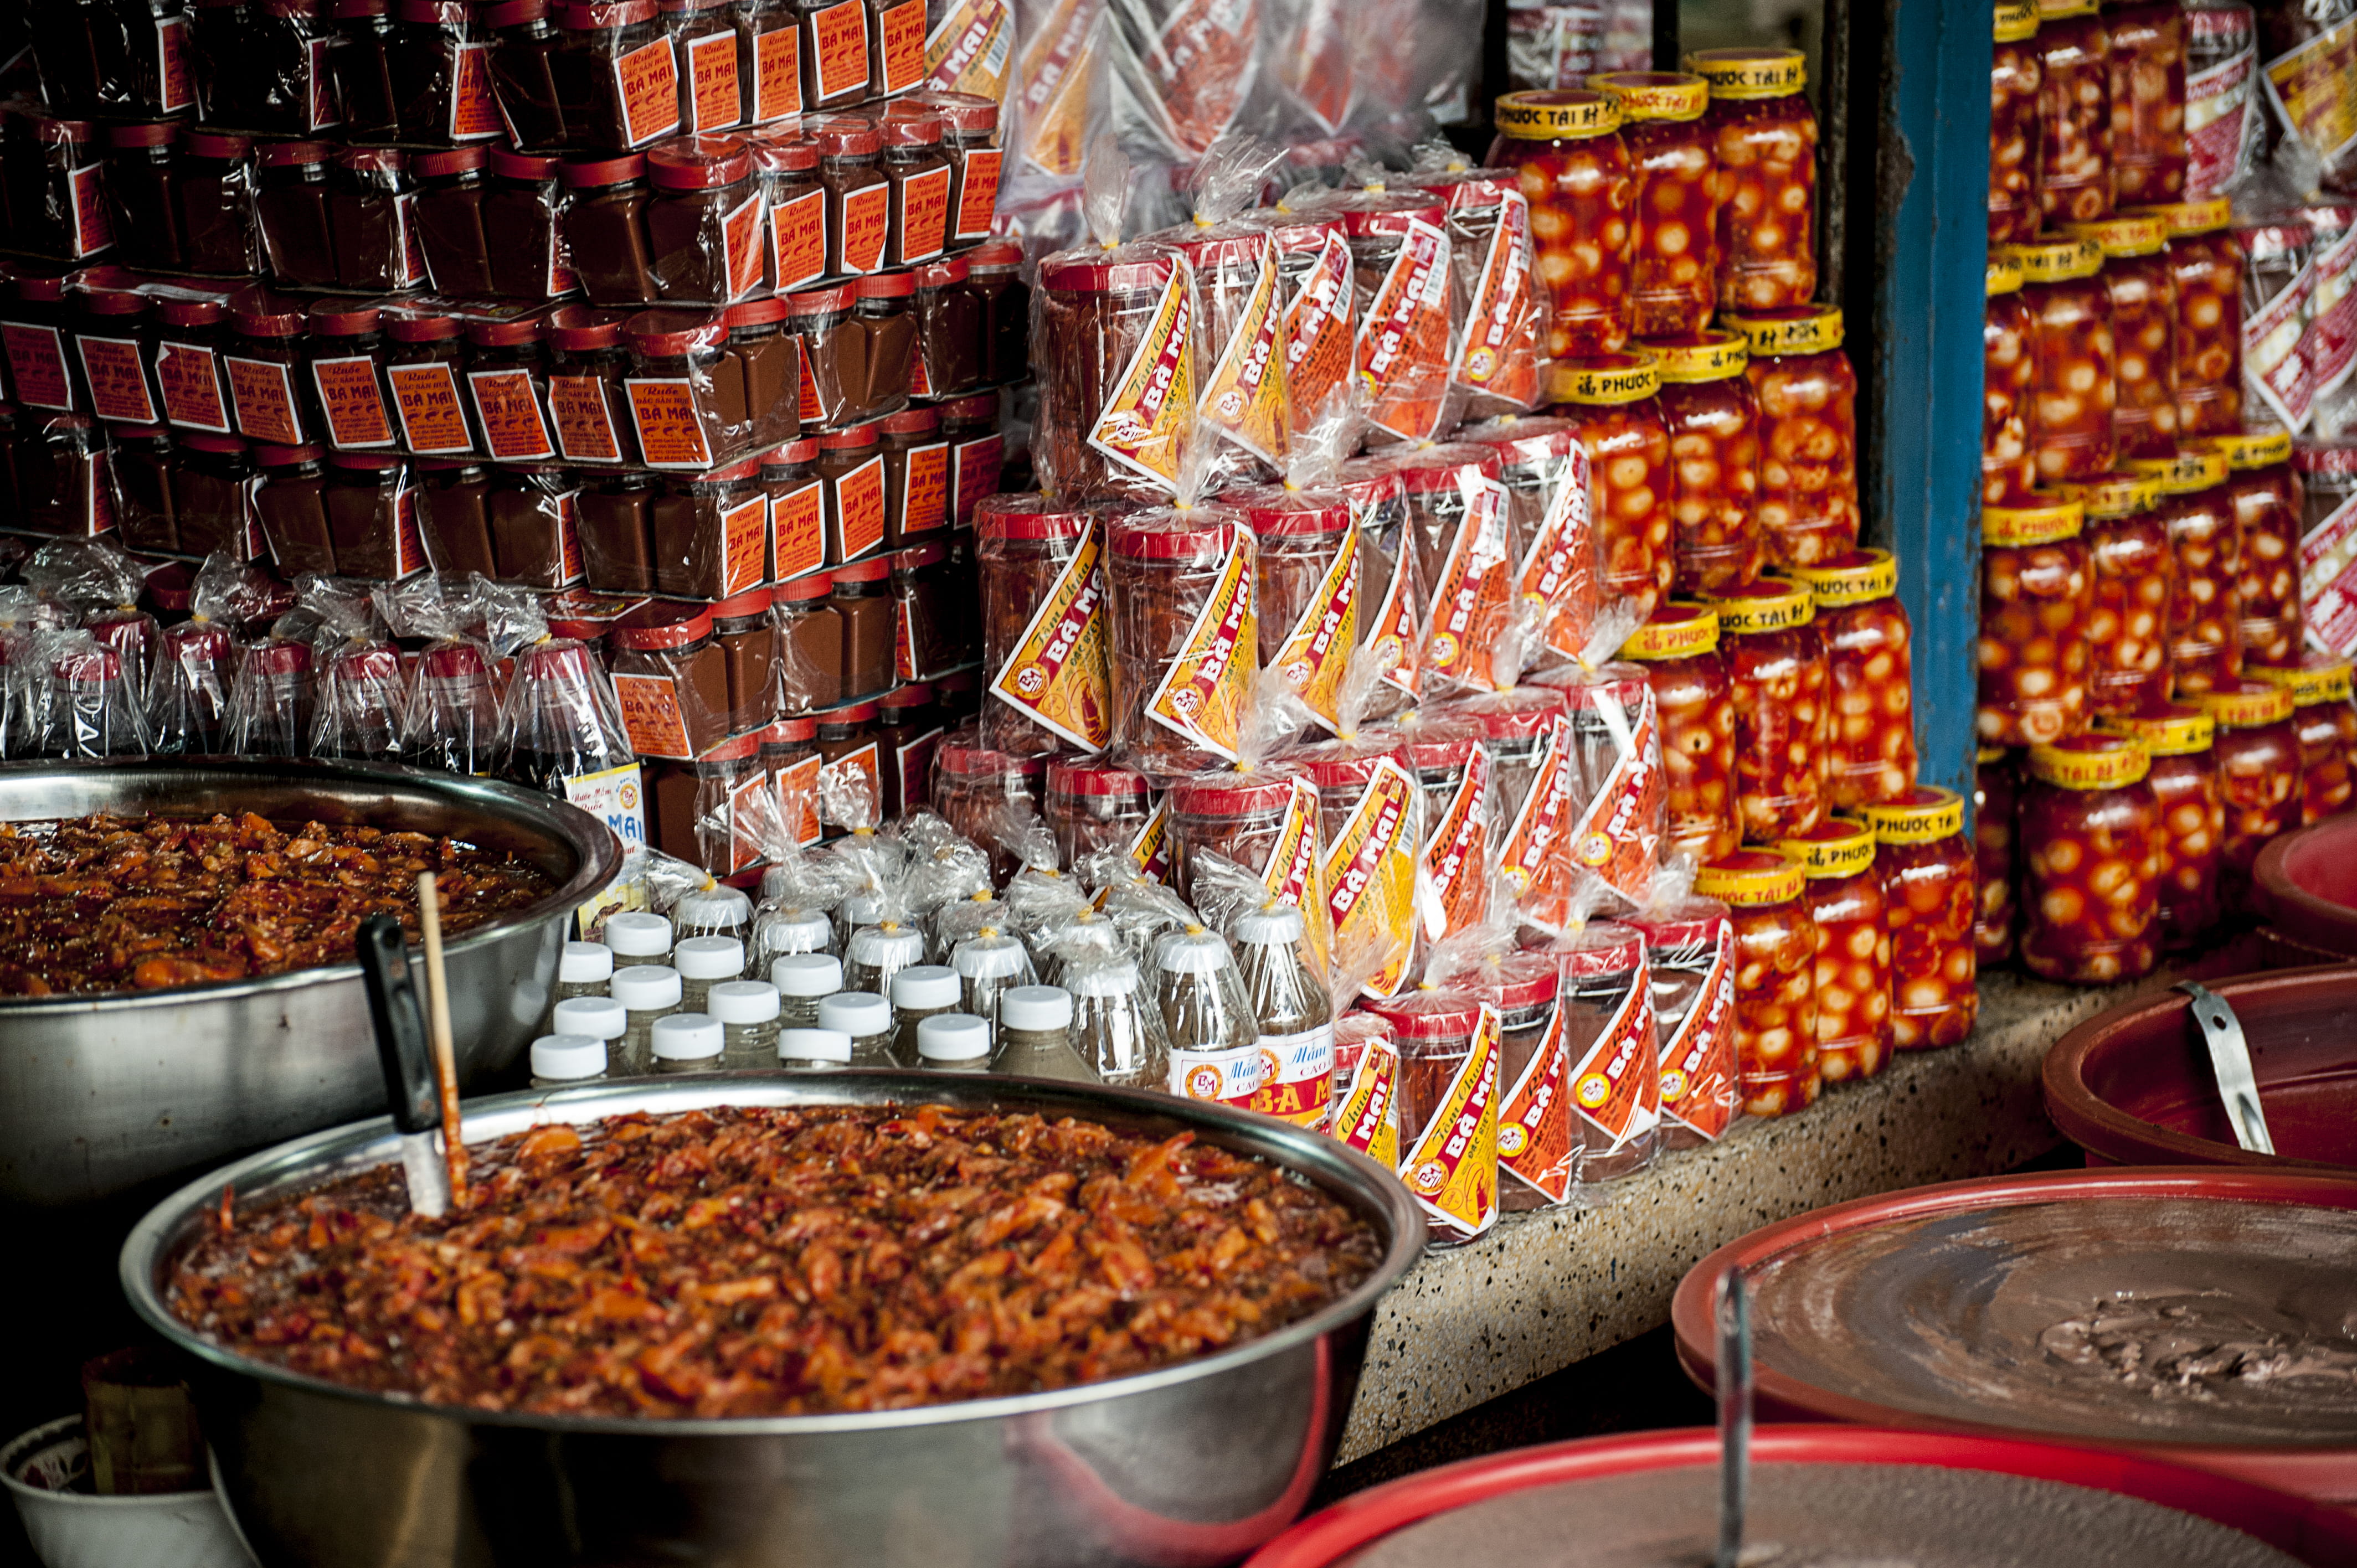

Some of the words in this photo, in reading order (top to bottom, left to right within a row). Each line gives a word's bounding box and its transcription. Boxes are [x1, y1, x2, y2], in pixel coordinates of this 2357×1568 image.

[945, 22, 987, 74] MAI
[1394, 266, 1428, 324] MAI
[1128, 357, 1156, 398] Tôm
[1152, 304, 1176, 351] Chua
[1143, 362, 1173, 410] BÀ
[1166, 298, 1190, 359] MAI
[1243, 338, 1271, 385] BÀ
[351, 385, 376, 399] MAI
[427, 391, 453, 405] MAI
[746, 524, 763, 543] MAI
[798, 509, 818, 529] MAI
[1325, 553, 1351, 597] Chua
[1031, 611, 1062, 652] Tôm
[1059, 562, 1091, 606] Chua
[1213, 576, 1236, 624] Chua
[1046, 618, 1080, 664] BÀ
[1201, 636, 1232, 685] BÀ
[1226, 569, 1250, 631] MAI
[1313, 609, 1341, 655] BÀ
[1142, 823, 1164, 857] Chu
[1457, 789, 1483, 847] MAI
[1277, 832, 1298, 879] Chua
[1290, 824, 1314, 884] MAI
[1328, 860, 1348, 891] ôm
[1346, 812, 1376, 855] Chua
[1331, 868, 1368, 912] BÀ
[1361, 806, 1398, 864] MAI
[1286, 1042, 1327, 1066] Mắm
[1300, 1061, 1325, 1077] CAO
[1607, 1035, 1637, 1080] BÀ
[1682, 1029, 1712, 1073] BÀ
[1198, 1075, 1215, 1092] BM
[1433, 1107, 1460, 1146] Tôm
[1458, 1056, 1485, 1101] Chua
[1445, 1113, 1477, 1159] BÀ
[1471, 1051, 1499, 1108] MAI
[1524, 1083, 1553, 1129] BÀ
[1341, 1089, 1370, 1135] Chua
[1356, 1081, 1388, 1141] MAI
